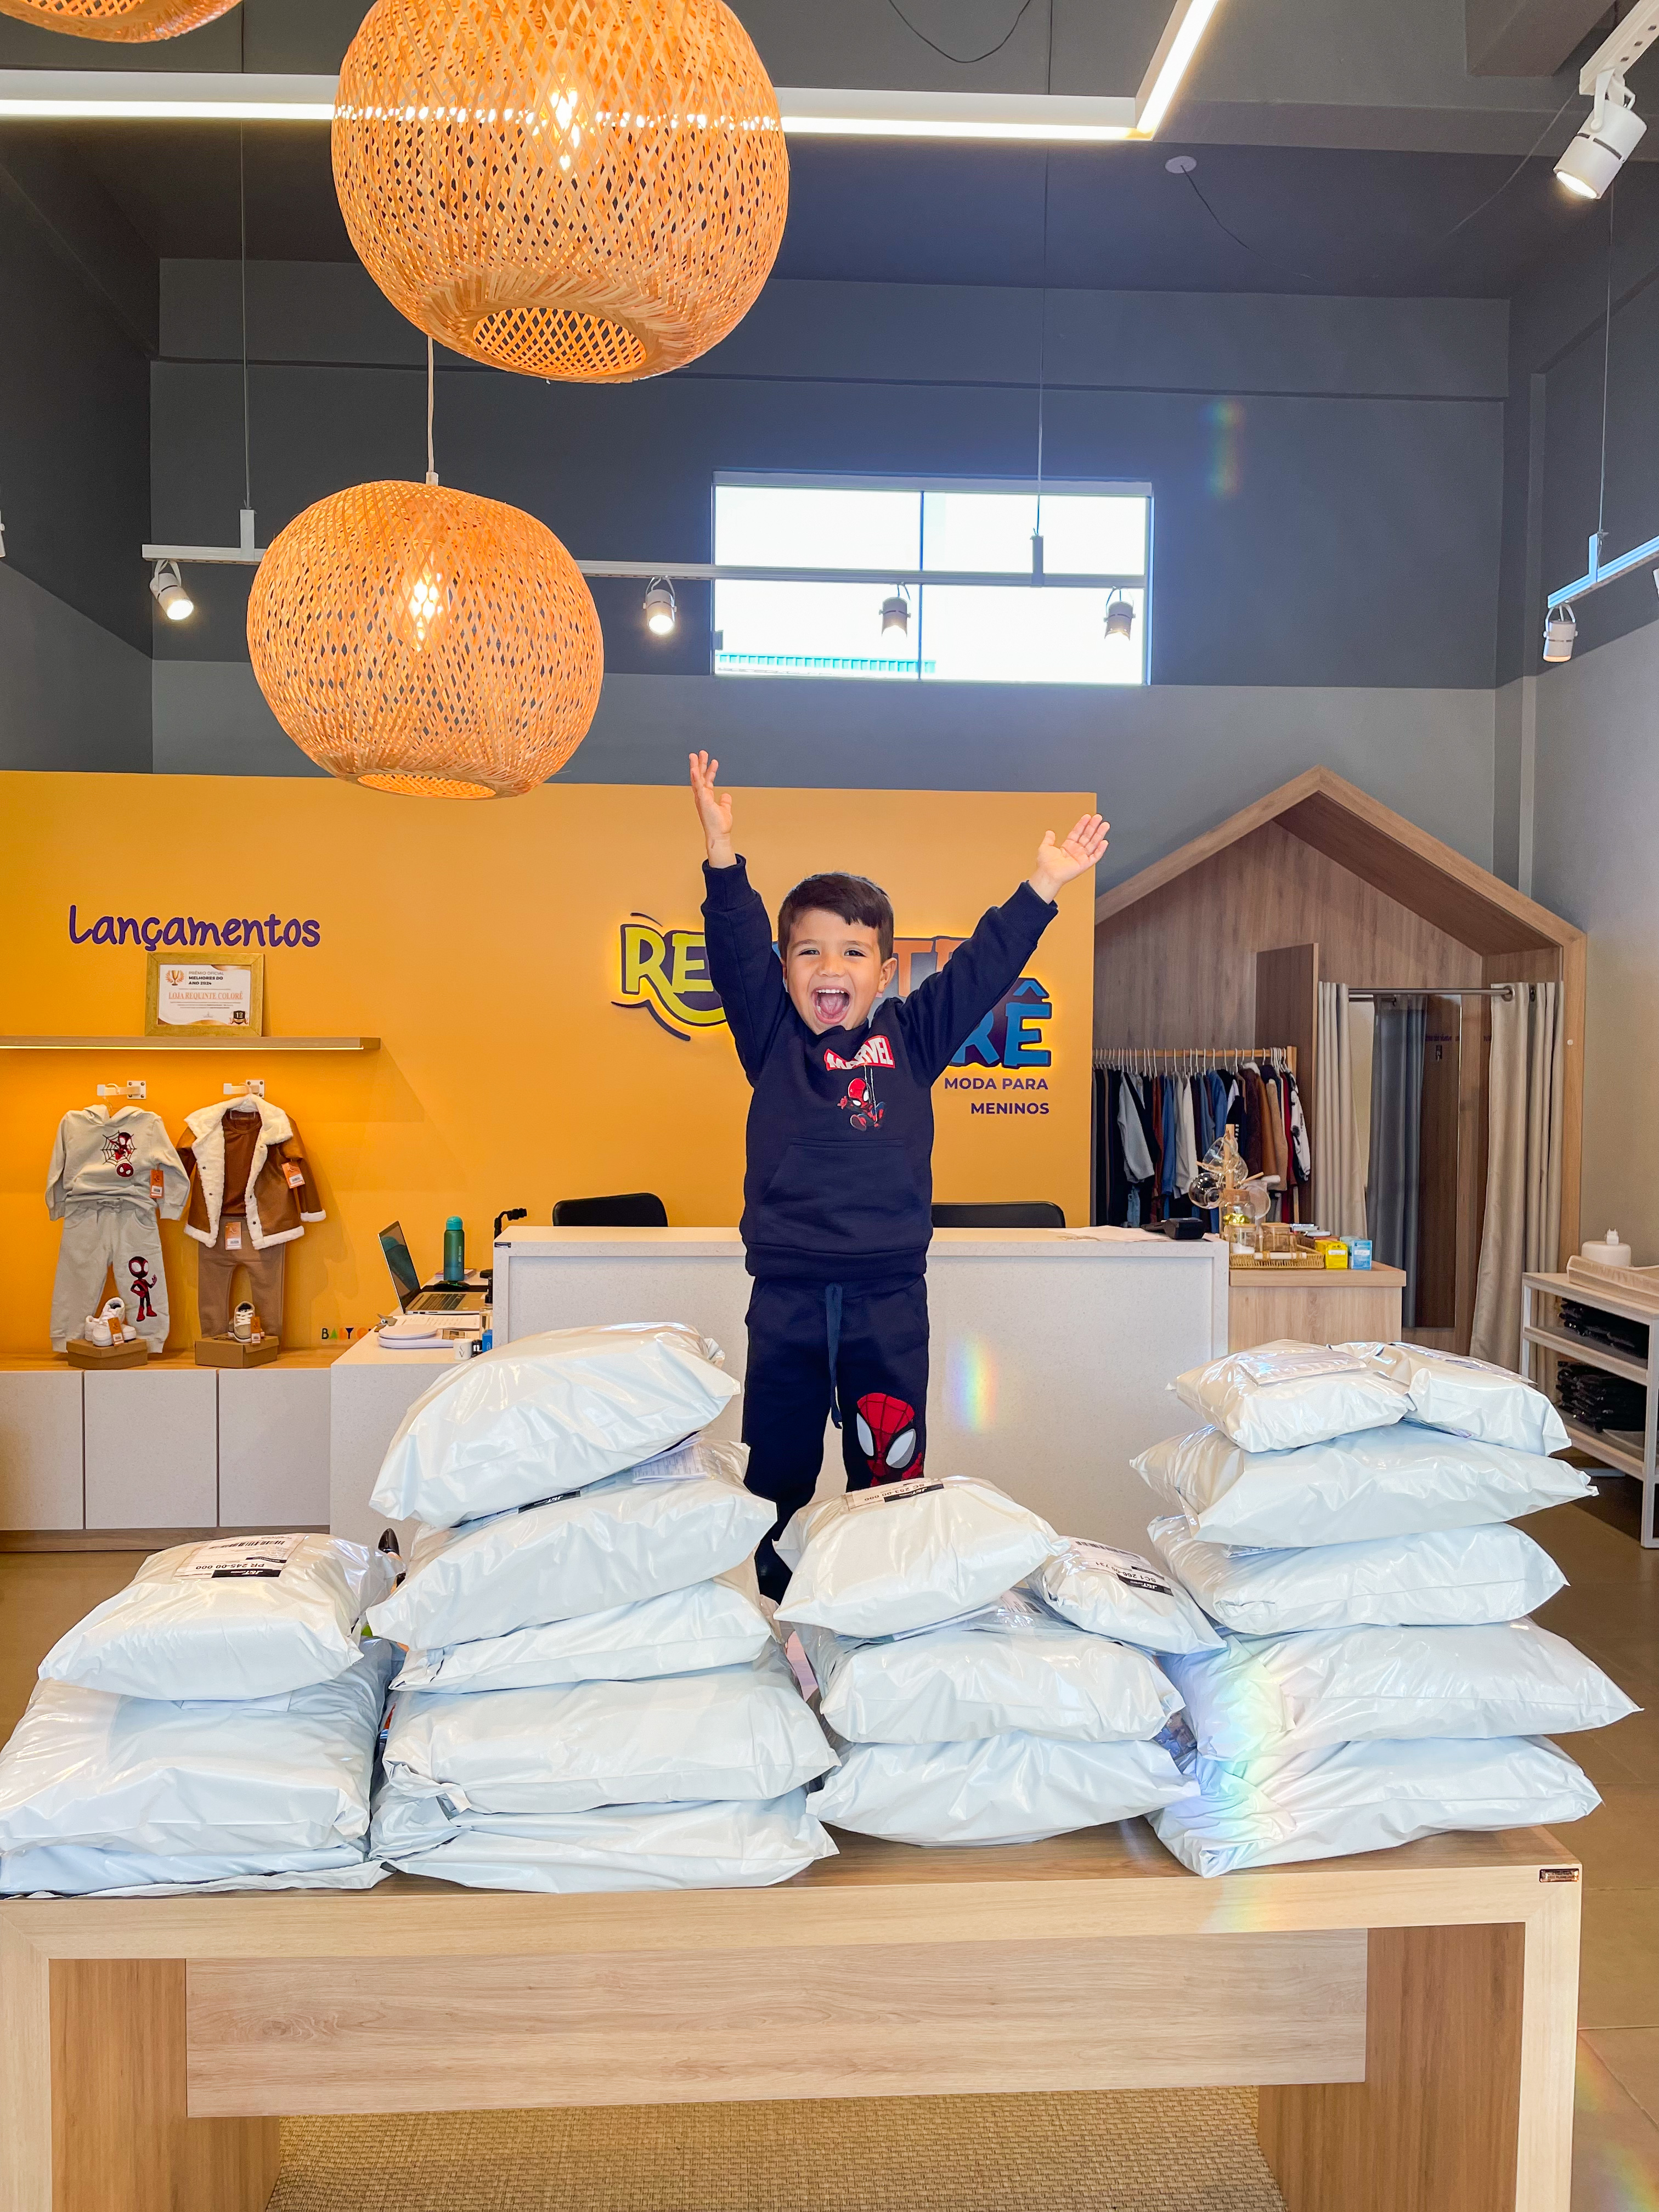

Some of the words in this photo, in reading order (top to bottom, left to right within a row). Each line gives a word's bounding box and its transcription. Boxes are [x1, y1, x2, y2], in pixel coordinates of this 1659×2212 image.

[69, 904, 321, 951] Lançamentos
[218, 990, 243, 1000] COLORÊ
[826, 1037, 894, 1069] MARVEL
[944, 1077, 997, 1090] MODA
[1002, 1078, 1048, 1090] PARA
[971, 1103, 1049, 1115] MENINOS
